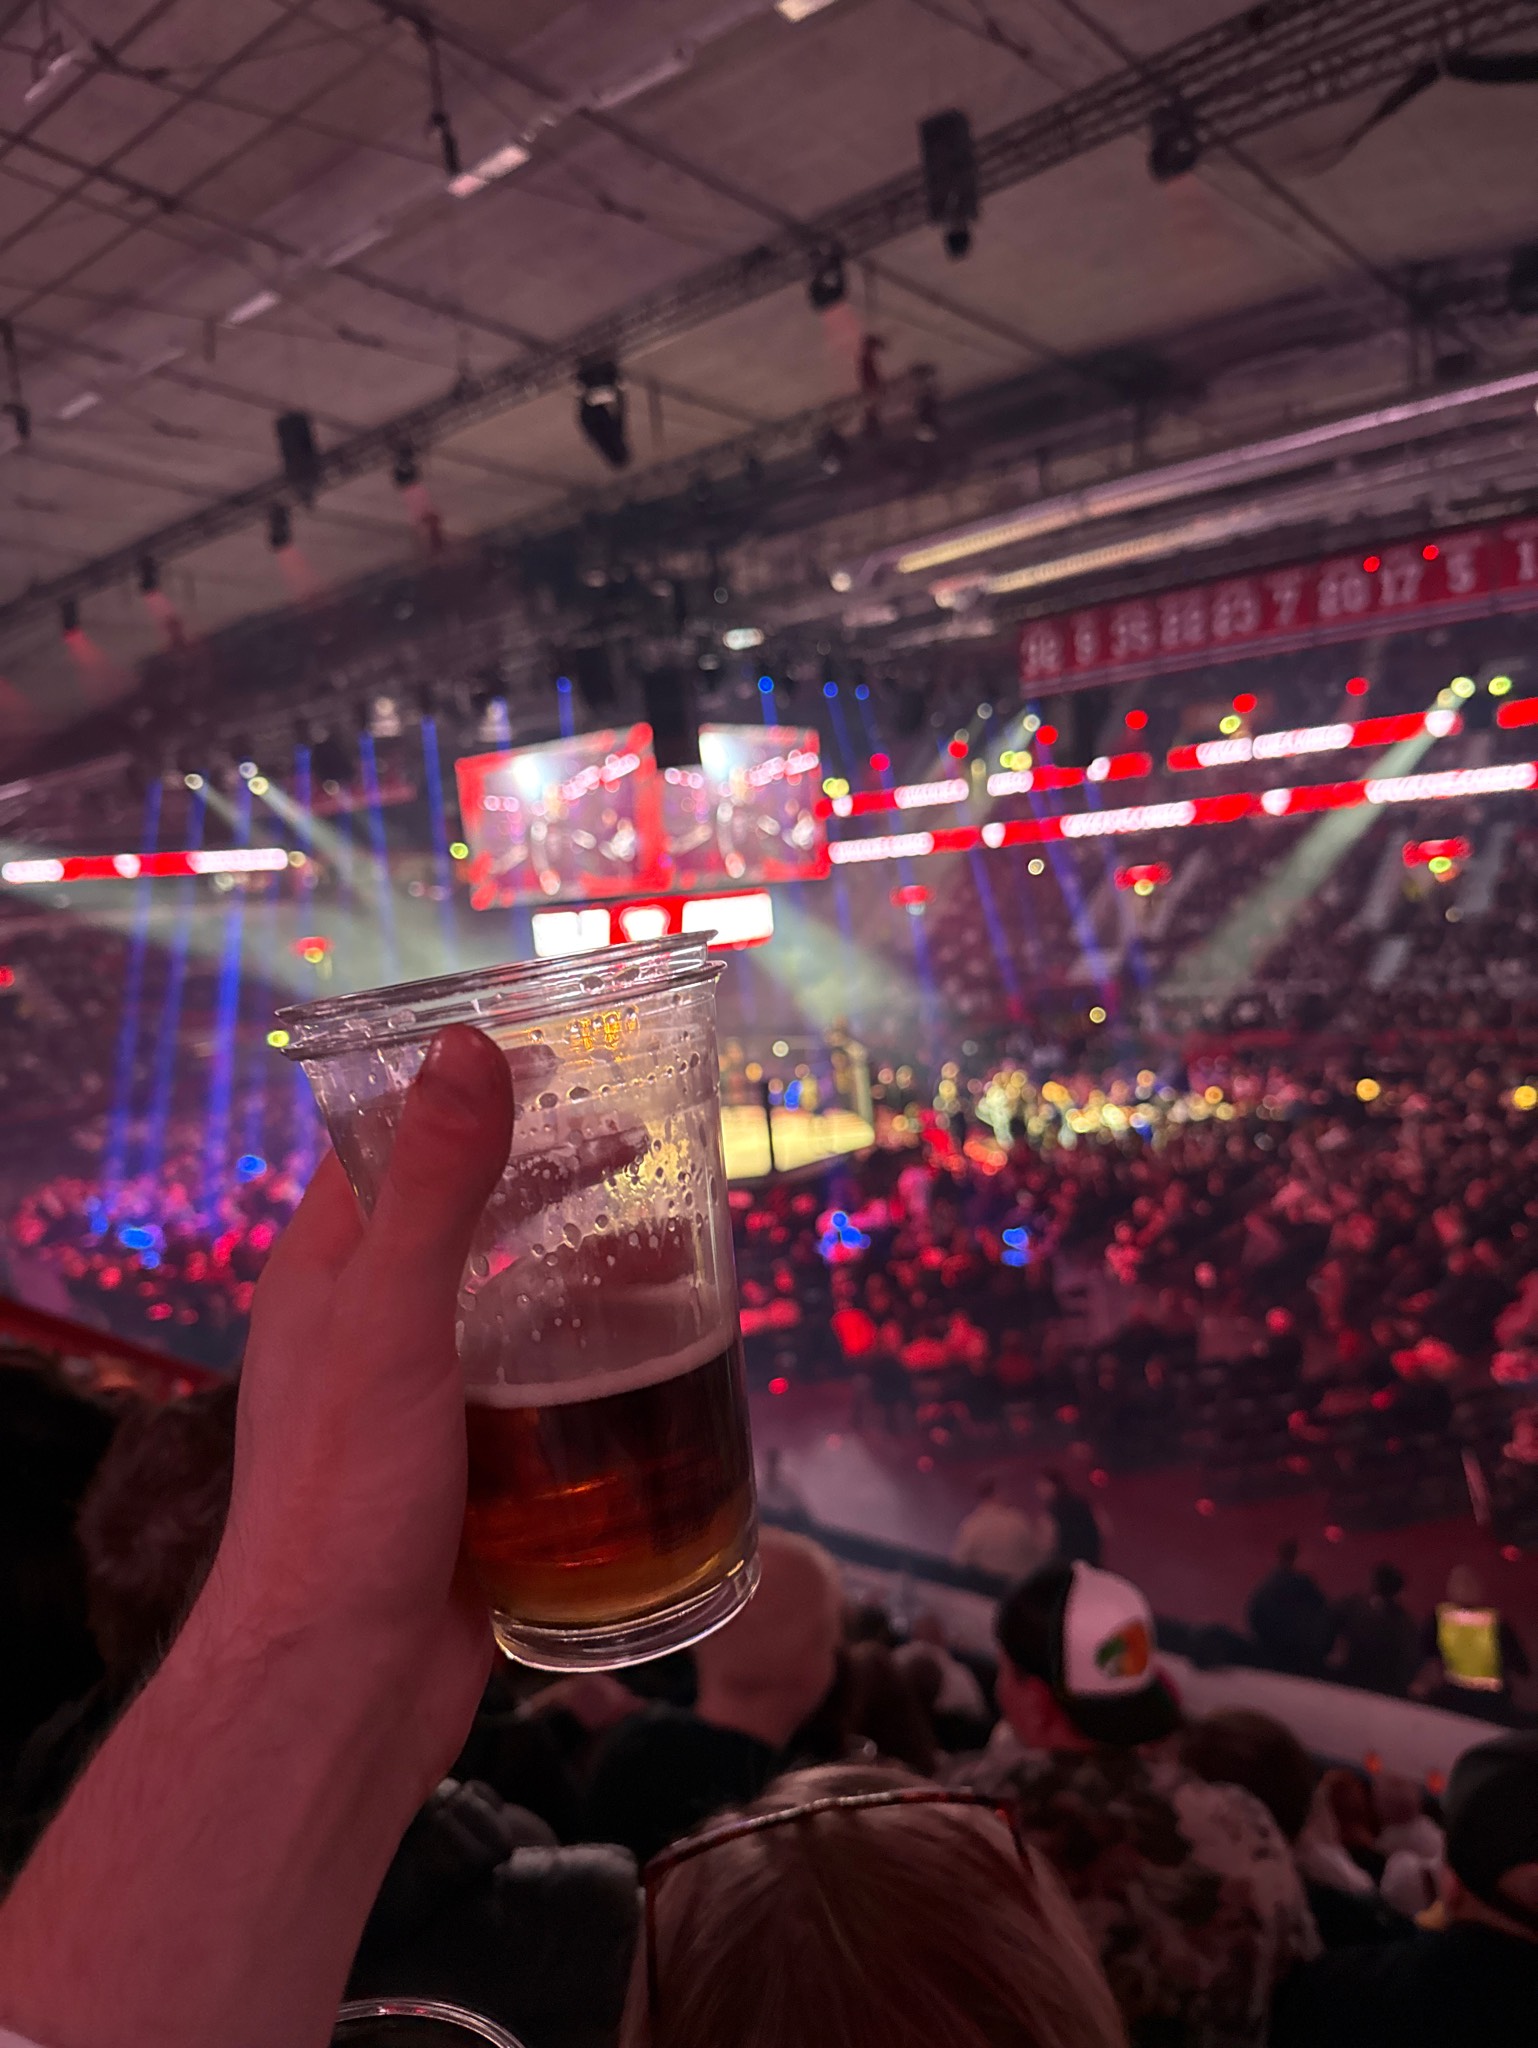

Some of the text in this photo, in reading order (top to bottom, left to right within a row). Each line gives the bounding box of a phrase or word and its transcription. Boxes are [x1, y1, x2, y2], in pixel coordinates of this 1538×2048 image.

[1273, 588, 1298, 627] 7
[1380, 561, 1423, 606] 17
[1447, 551, 1475, 594] 5
